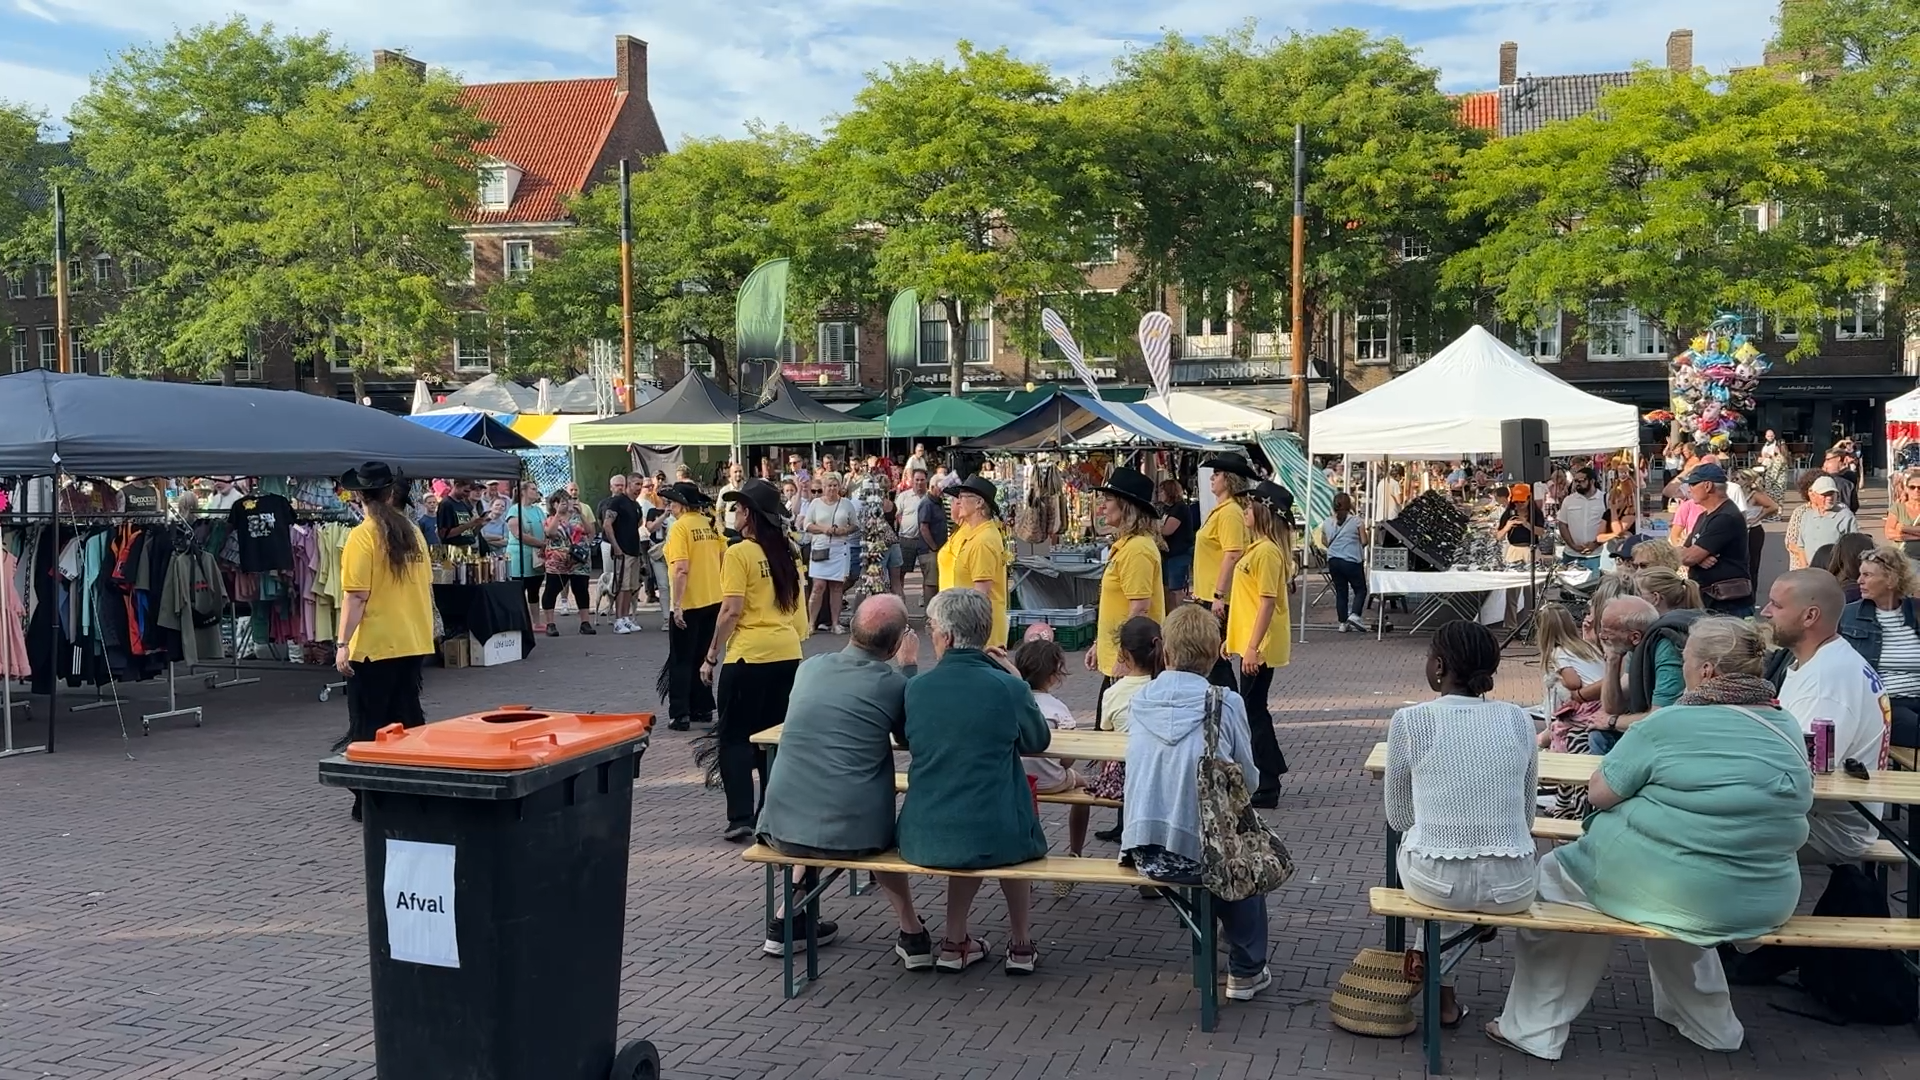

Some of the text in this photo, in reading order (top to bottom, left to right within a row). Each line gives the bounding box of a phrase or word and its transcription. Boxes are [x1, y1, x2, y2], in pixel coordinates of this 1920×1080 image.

[913, 373, 938, 383] otel
[1035, 369, 1055, 380] de
[1208, 365, 1270, 379] NEMO'S
[396, 891, 445, 914] Afval
